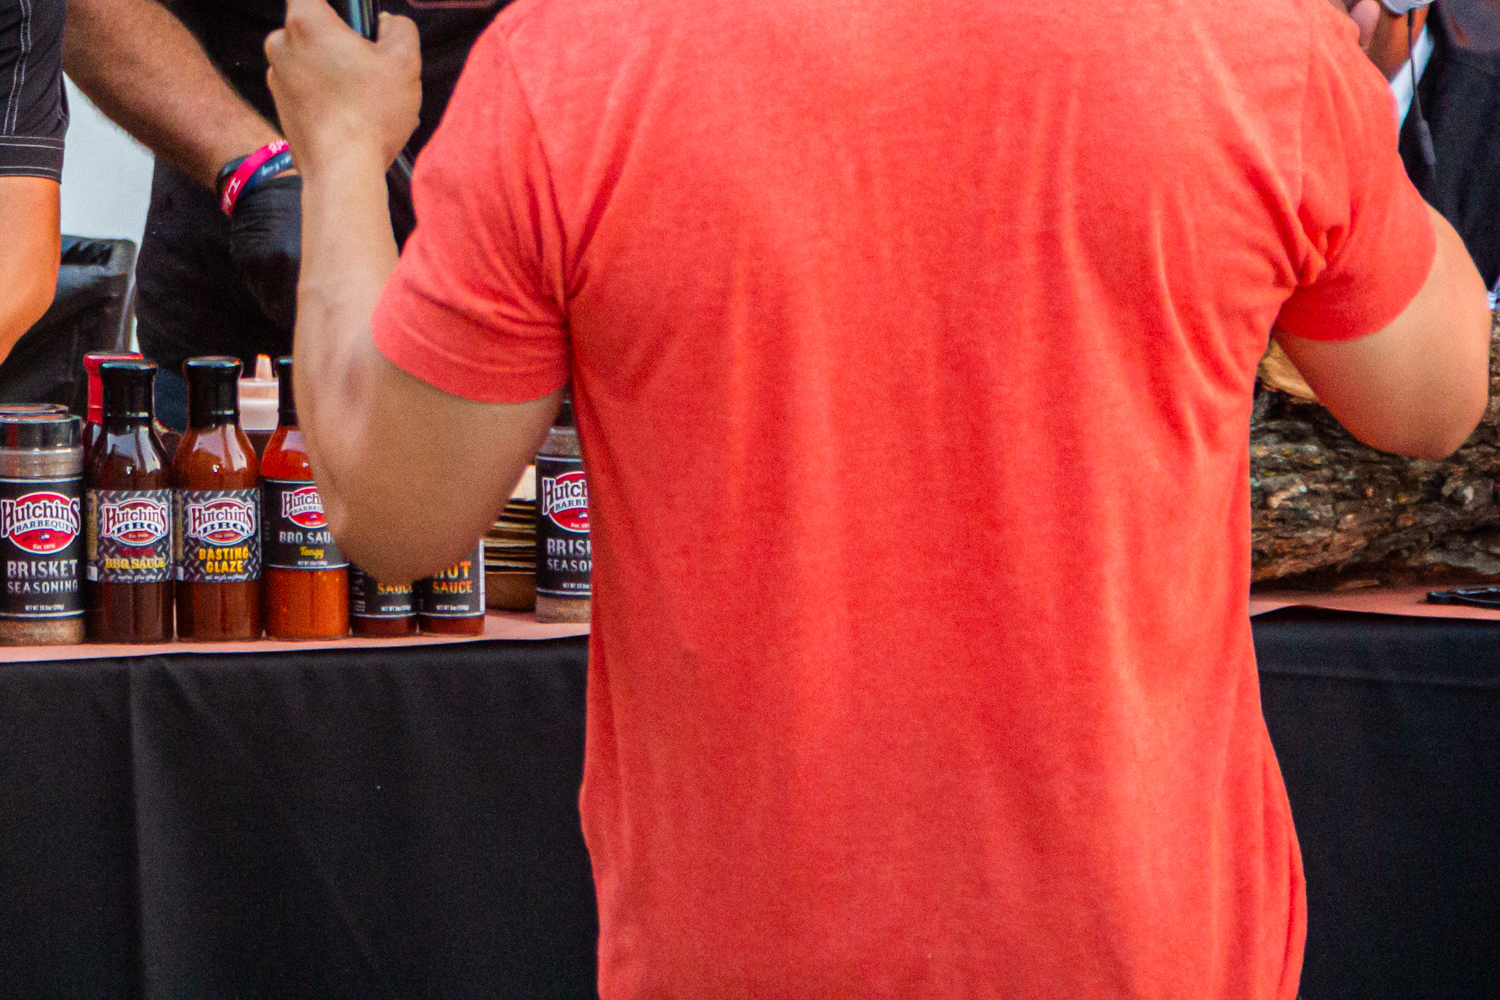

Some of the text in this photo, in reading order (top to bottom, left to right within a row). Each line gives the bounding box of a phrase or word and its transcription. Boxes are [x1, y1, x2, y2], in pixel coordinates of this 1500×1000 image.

[283, 492, 322, 516] Hutch
[16, 519, 71, 533] BARBEQUE
[115, 521, 159, 536] BBQ
[202, 521, 246, 535] BBQ
[307, 531, 334, 544] SAU
[198, 547, 249, 560] BASTING
[300, 546, 325, 559] Tangy
[7, 559, 78, 579] BRISKET
[104, 557, 166, 569] BBQ SAUCE
[205, 560, 243, 574] GLAZE
[7, 580, 78, 595] SEASONING
[432, 580, 473, 594] SAUCE
